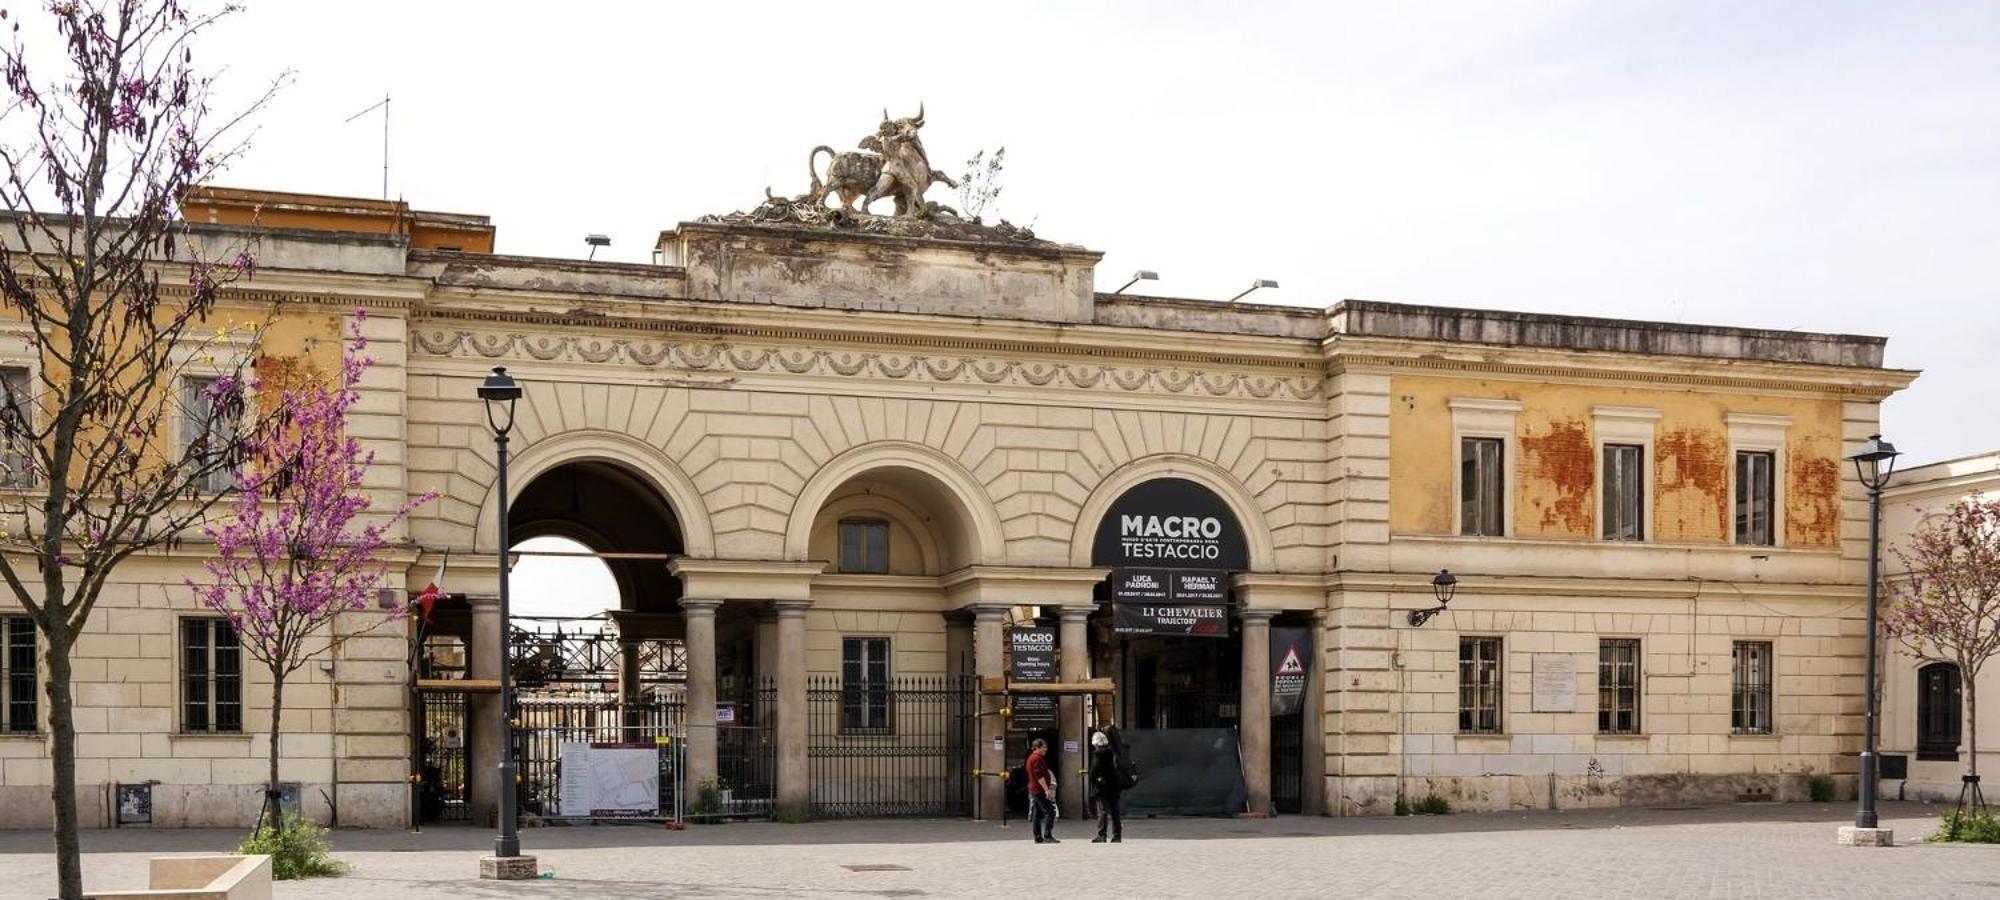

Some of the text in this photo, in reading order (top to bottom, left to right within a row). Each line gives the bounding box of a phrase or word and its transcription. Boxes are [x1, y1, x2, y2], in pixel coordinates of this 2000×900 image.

[1121, 514, 1221, 538] MACRO
[1122, 542, 1219, 559] TESTACCIO
[1181, 576, 1210, 584] RAFAEL
[1125, 581, 1160, 589] PADRONI
[1143, 607, 1224, 618] LI CHEVALIER
[1157, 617, 1197, 625] TRAJECTORY
[1012, 633, 1054, 642] MACRO
